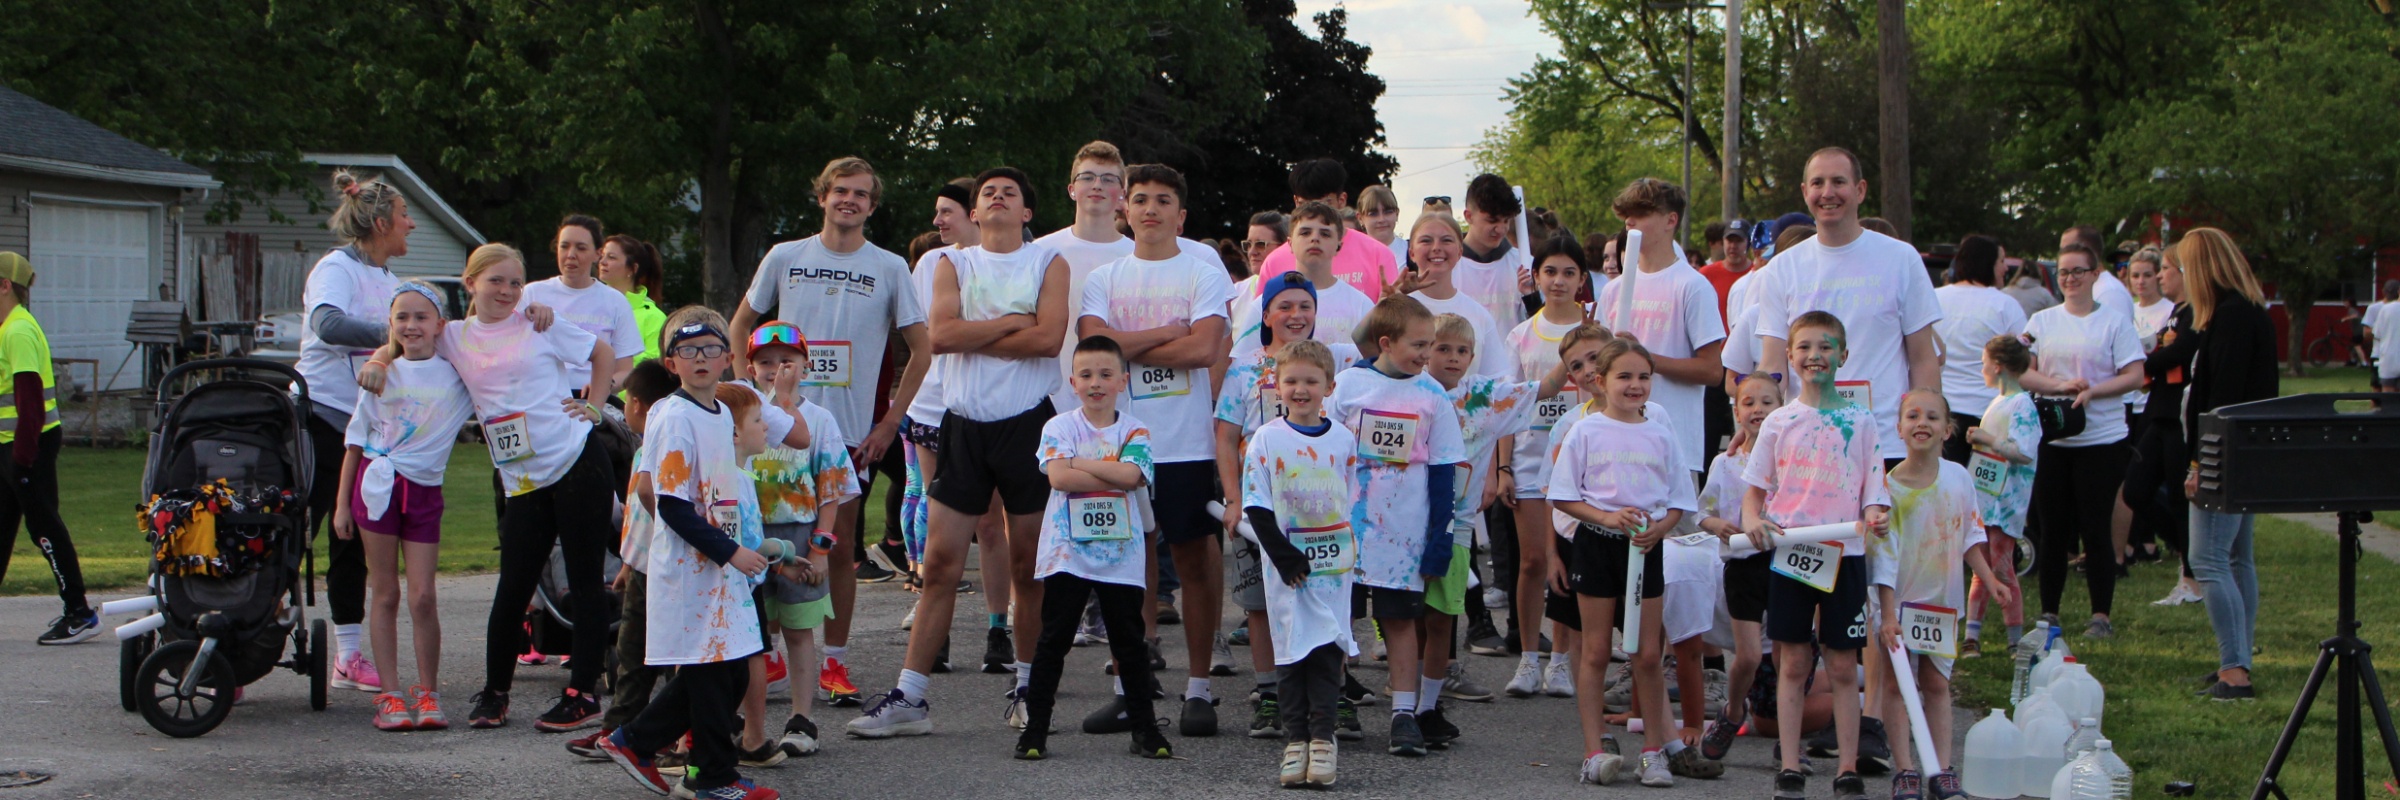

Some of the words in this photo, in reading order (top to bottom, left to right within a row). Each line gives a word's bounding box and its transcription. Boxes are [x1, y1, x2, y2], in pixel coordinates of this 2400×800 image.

[789, 268, 876, 288] PURDUE
[1352, 271, 1364, 284] 5K
[1821, 276, 1866, 291] DONOVAN
[1135, 285, 1176, 299] DONOVAN
[830, 350, 836, 358] 5K
[808, 359, 839, 373] 135
[1142, 368, 1176, 385] 084
[1848, 390, 1855, 399] 5K
[1539, 404, 1567, 417] 056
[1374, 420, 1386, 430] 2024
[1387, 423, 1397, 431] DHS
[1398, 423, 1405, 431] 5K
[497, 433, 522, 450] 072
[1372, 431, 1405, 448] 024
[1789, 463, 1839, 486] DONOVAN
[1975, 466, 1997, 483] 083
[1084, 502, 1096, 511] 2024
[1097, 502, 1106, 510] DHS
[1107, 501, 1114, 510] 5K
[1082, 512, 1117, 527] 089
[1305, 536, 1317, 545] 2024
[1318, 535, 1328, 543] DHS
[1304, 543, 1340, 561] 059
[1792, 543, 1806, 552] 2024
[1806, 545, 1816, 556] DHS
[1816, 547, 1824, 557] 5K
[40, 536, 67, 592] Champion
[1787, 552, 1825, 574] 087
[1914, 614, 1925, 623] 2024
[1911, 625, 1942, 643] 010
